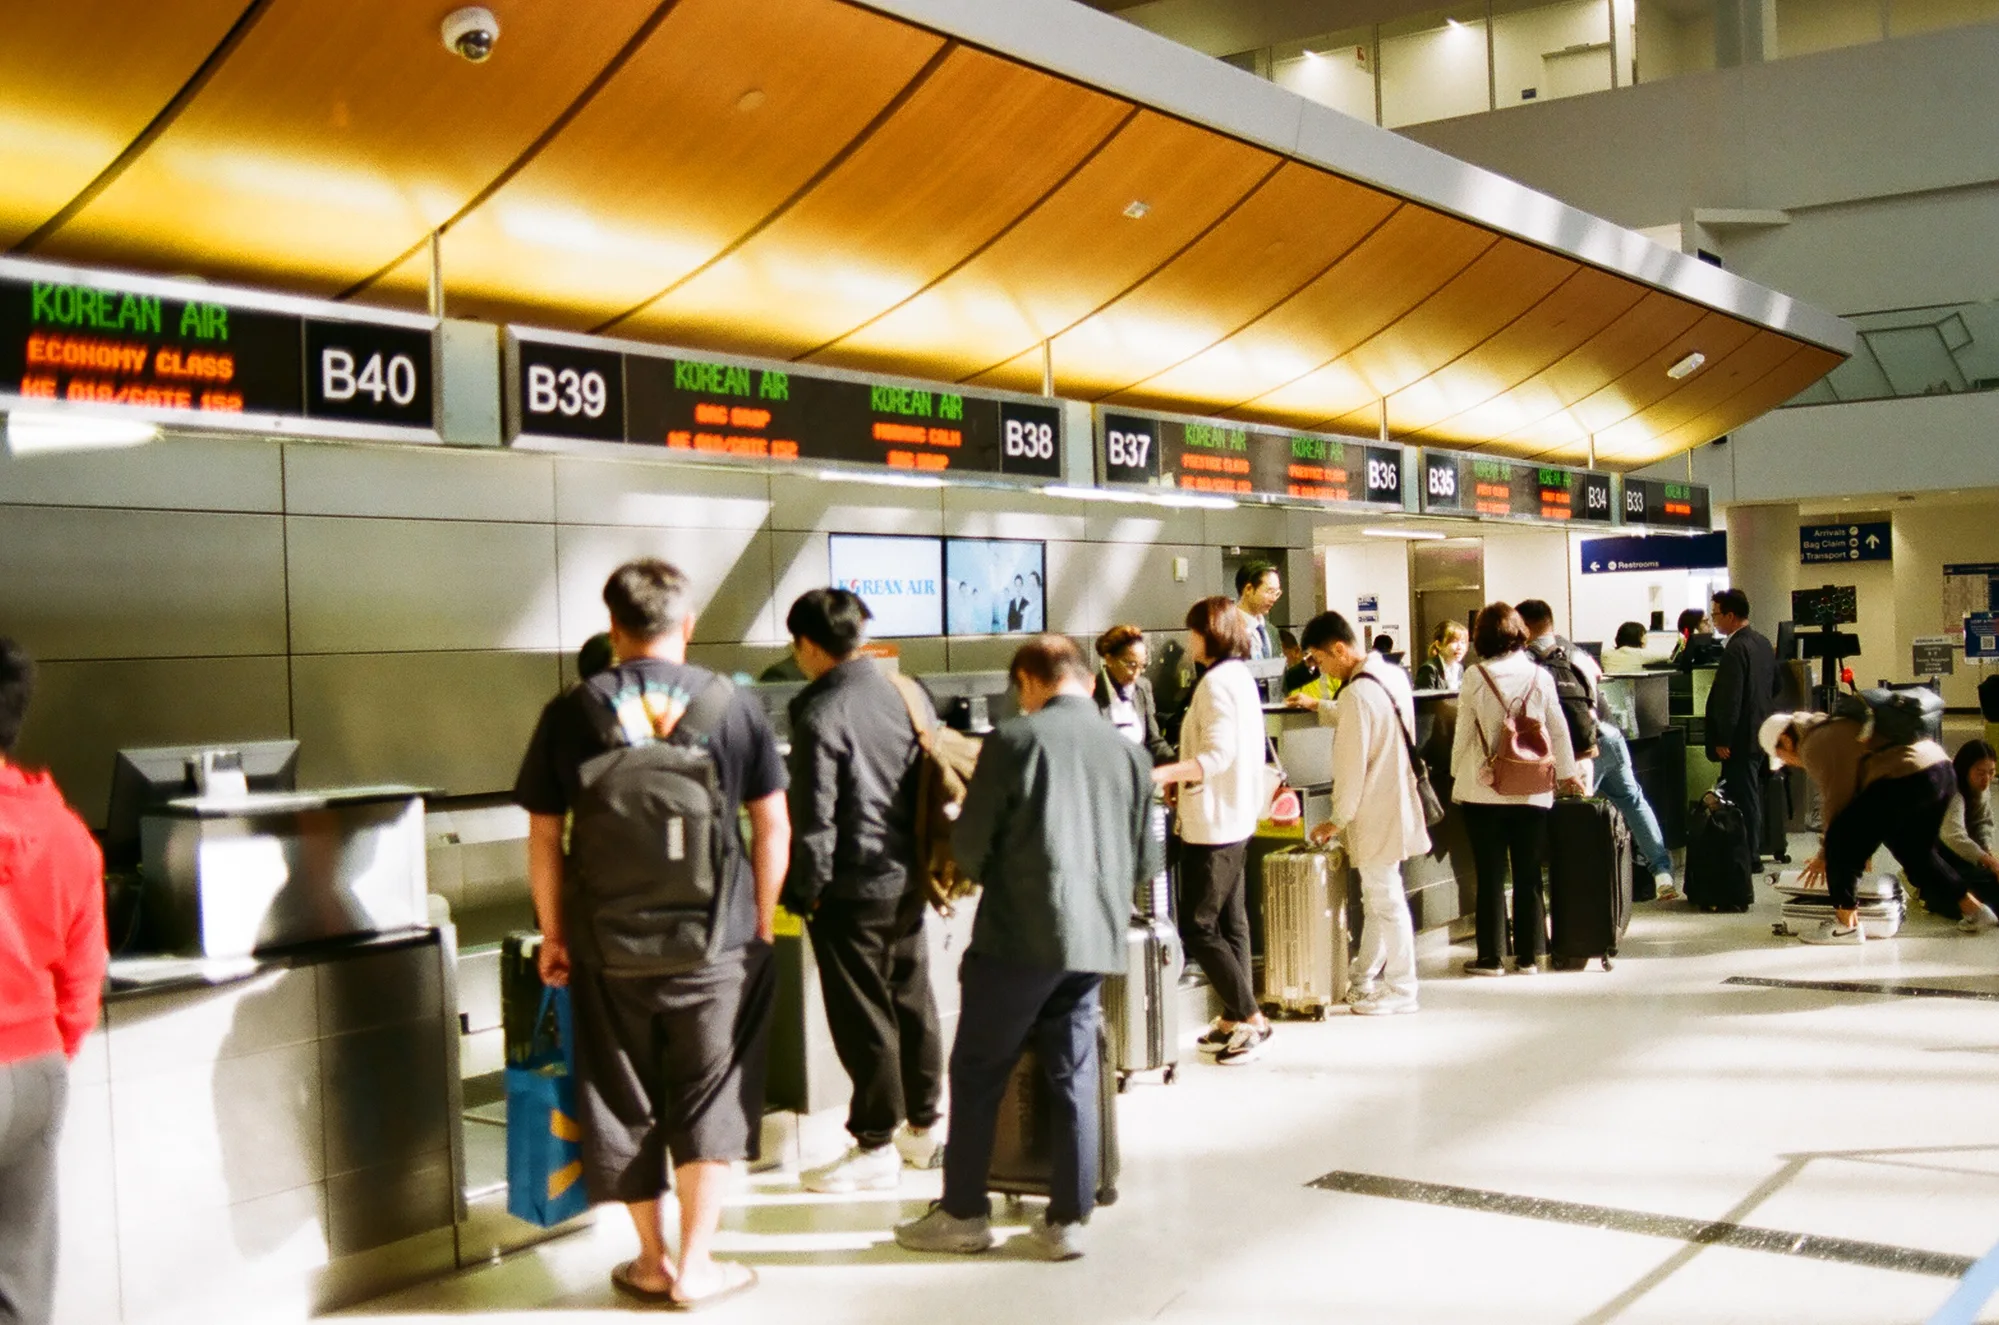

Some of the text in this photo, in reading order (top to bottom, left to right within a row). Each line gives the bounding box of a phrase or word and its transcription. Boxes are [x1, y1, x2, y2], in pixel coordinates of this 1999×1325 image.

[31, 281, 228, 341] KOREAN AIR
[27, 334, 235, 383] ECONOMY CLASS
[322, 348, 416, 405] B40
[527, 365, 607, 418] B39
[674, 360, 789, 401] KOREAN AIR
[871, 385, 963, 421] KOREAN AIR
[1005, 419, 1054, 460] B38
[1109, 430, 1151, 468] B37
[1368, 459, 1397, 490] B36
[1429, 467, 1455, 496] B35
[1588, 486, 1607, 509] B34
[1626, 490, 1644, 512] B33
[1803, 540, 1846, 549] Bag Claim
[1813, 529, 1846, 537] Arrivals
[1617, 561, 1659, 569] Restrooms
[1806, 551, 1847, 560] Transport
[906, 579, 936, 595] AIR
